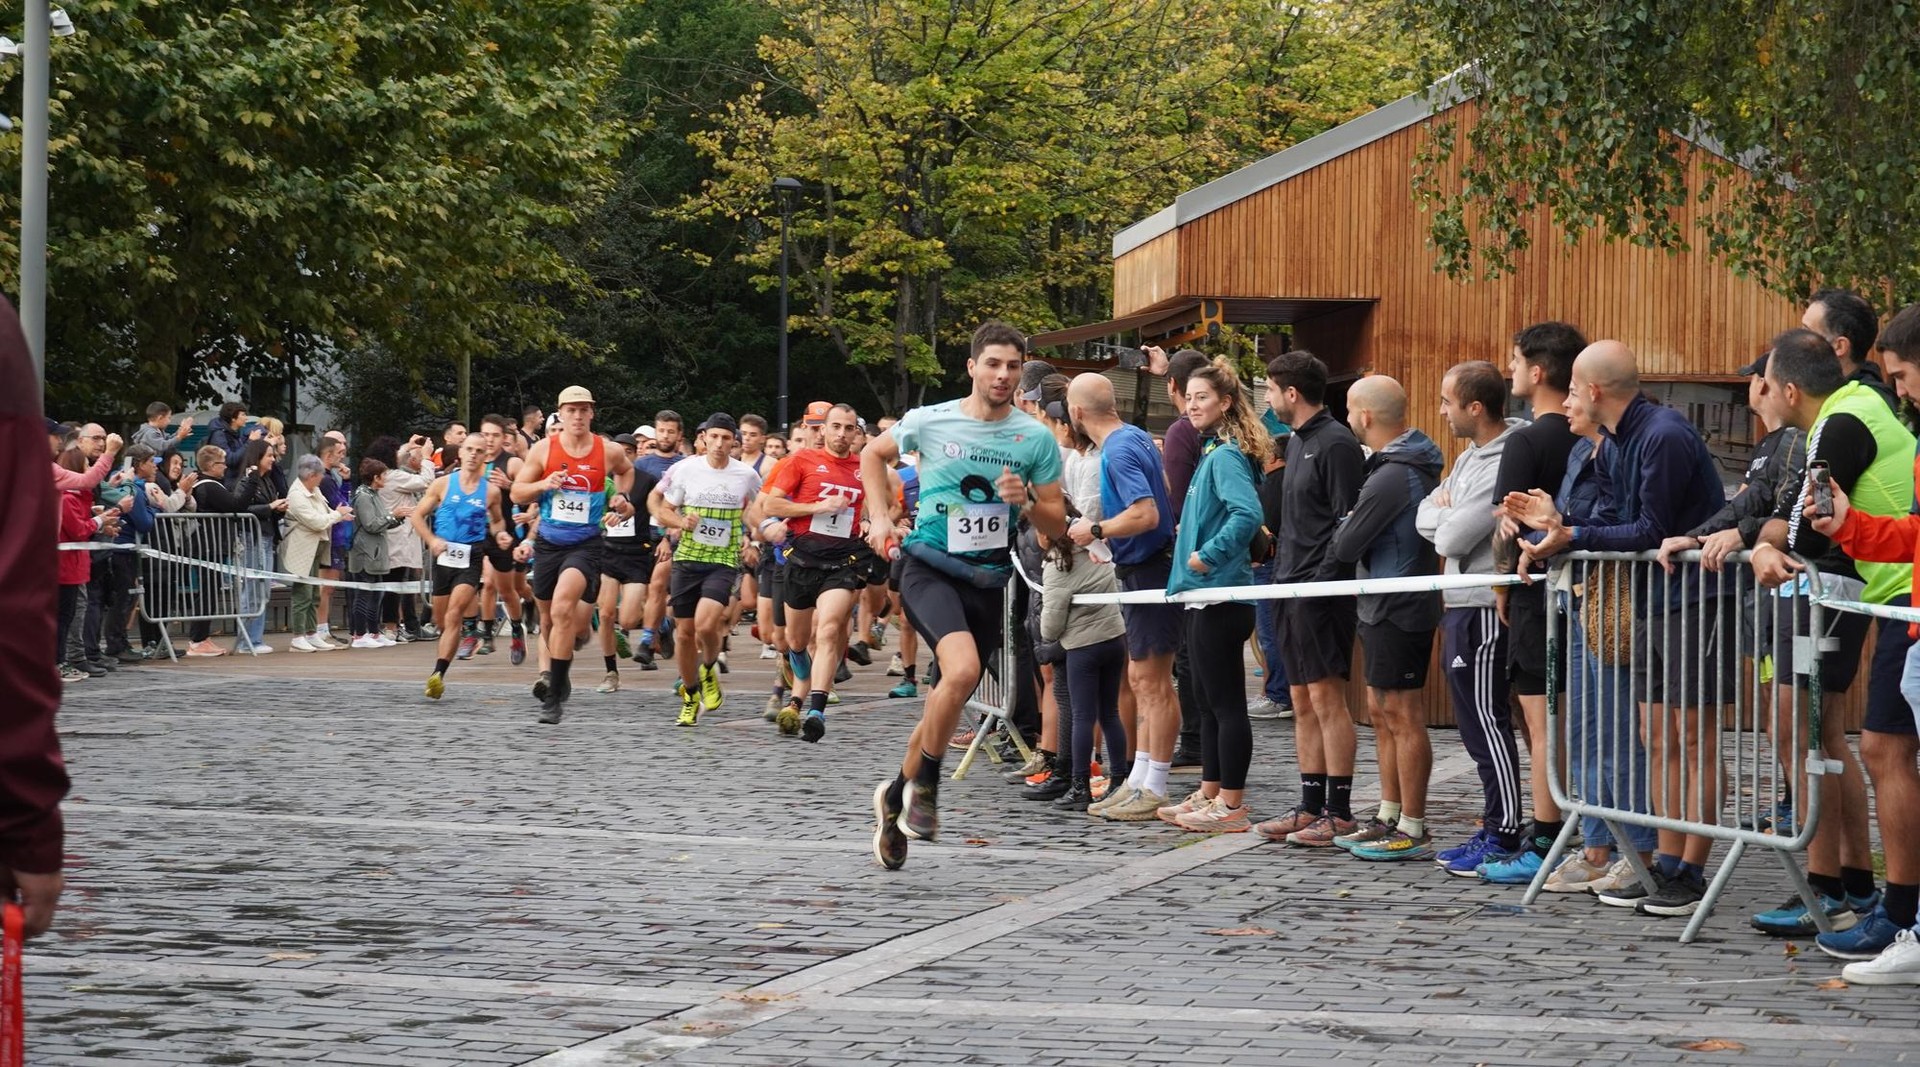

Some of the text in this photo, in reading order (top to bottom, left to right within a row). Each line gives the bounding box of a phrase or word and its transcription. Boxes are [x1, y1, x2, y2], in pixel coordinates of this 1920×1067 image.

[970, 454, 1021, 468] ammma
[818, 482, 862, 504] ZTT
[558, 499, 584, 512] 344
[830, 514, 838, 525] 1
[958, 516, 1000, 534] 316
[700, 525, 725, 537] 267
